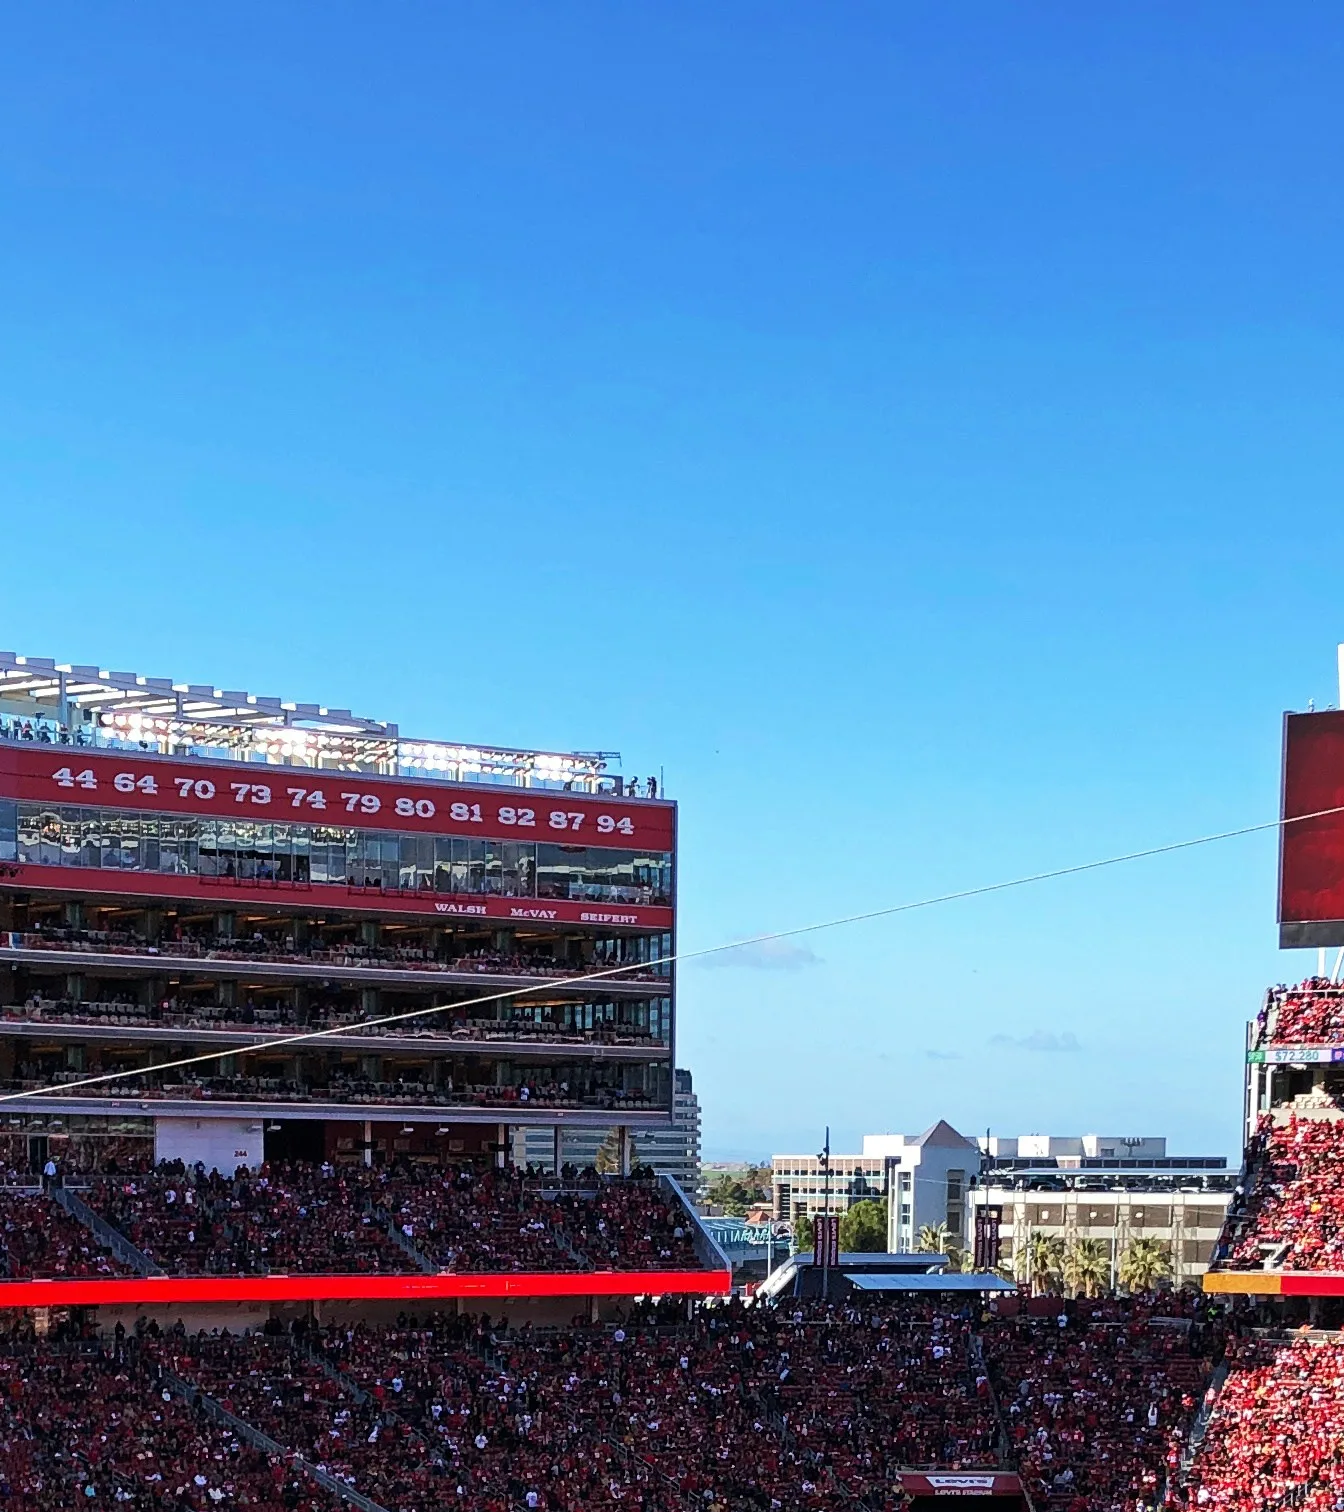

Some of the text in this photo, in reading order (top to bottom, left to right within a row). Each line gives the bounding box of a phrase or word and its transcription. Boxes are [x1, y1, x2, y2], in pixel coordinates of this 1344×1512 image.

[52, 767, 635, 836] 44 64 70 73 74 79 80 81 82 87 94
[434, 902, 487, 916] WALSH
[580, 912, 638, 925] SEIFERT
